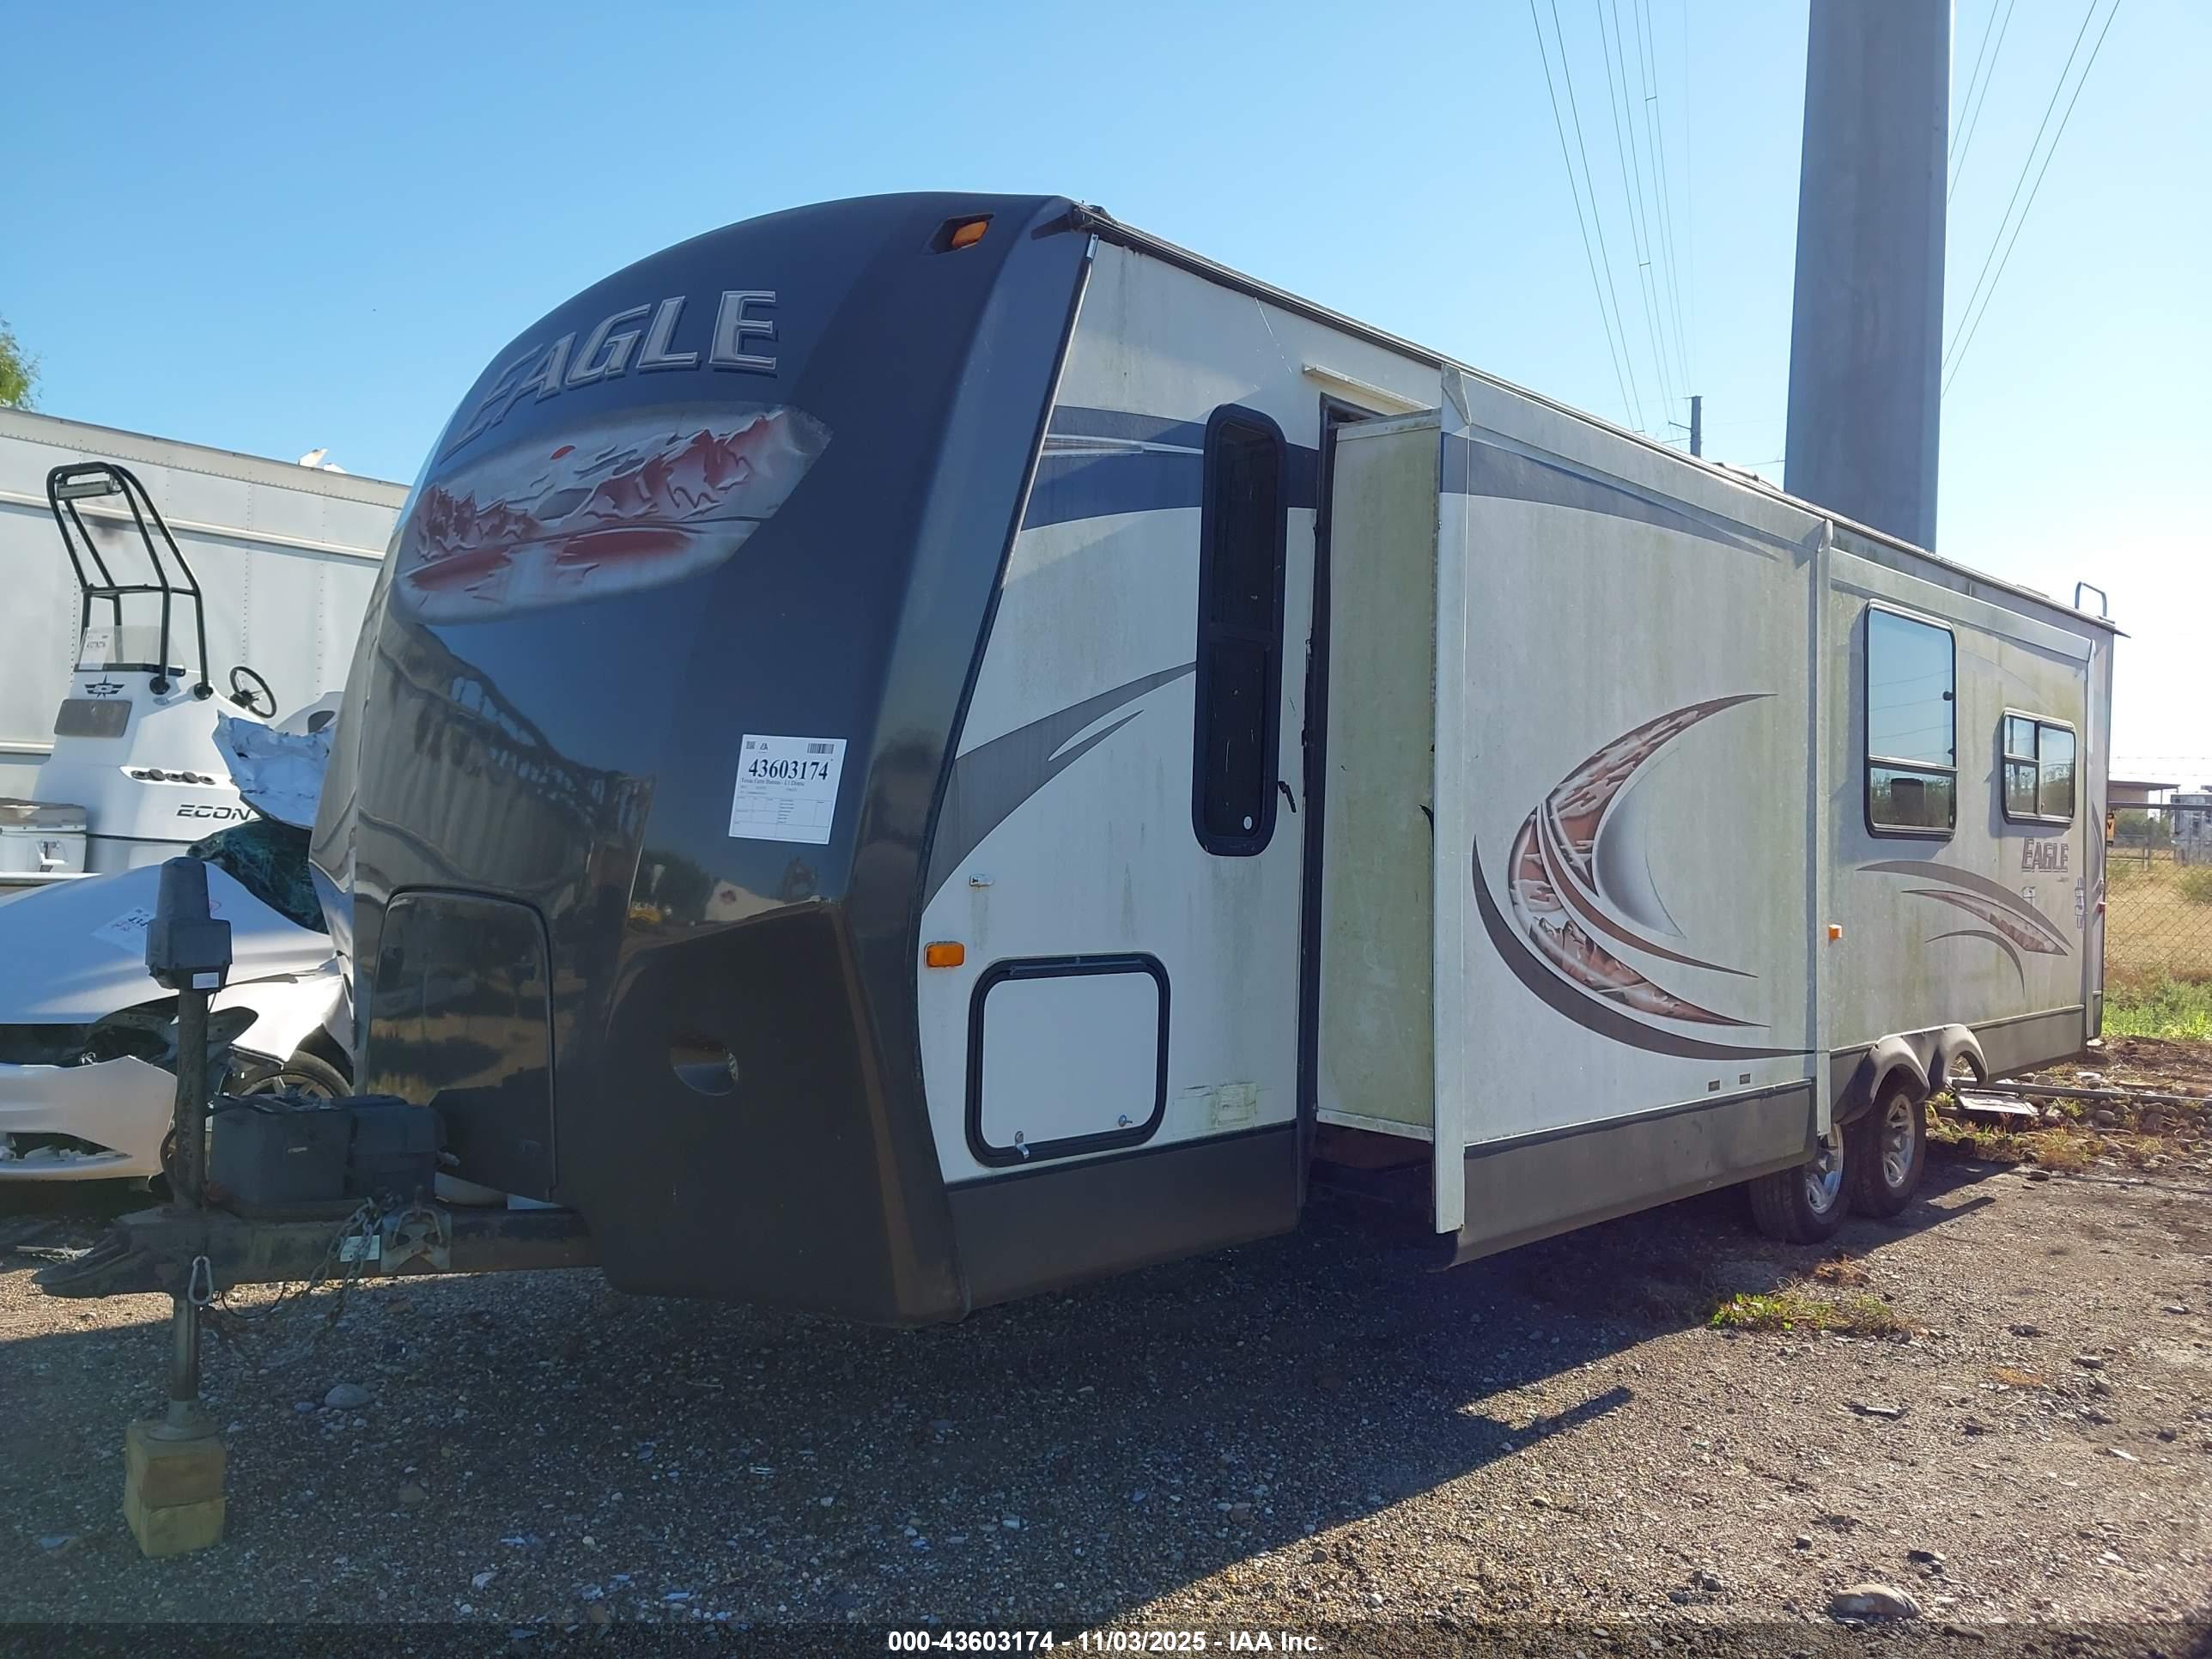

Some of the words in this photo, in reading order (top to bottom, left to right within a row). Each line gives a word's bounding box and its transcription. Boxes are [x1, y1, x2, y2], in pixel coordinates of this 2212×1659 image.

[440, 290, 778, 465] EAGLE
[748, 758, 830, 781] 43603174
[177, 804, 252, 821] ECON
[2021, 837, 2069, 873] EAGLE
